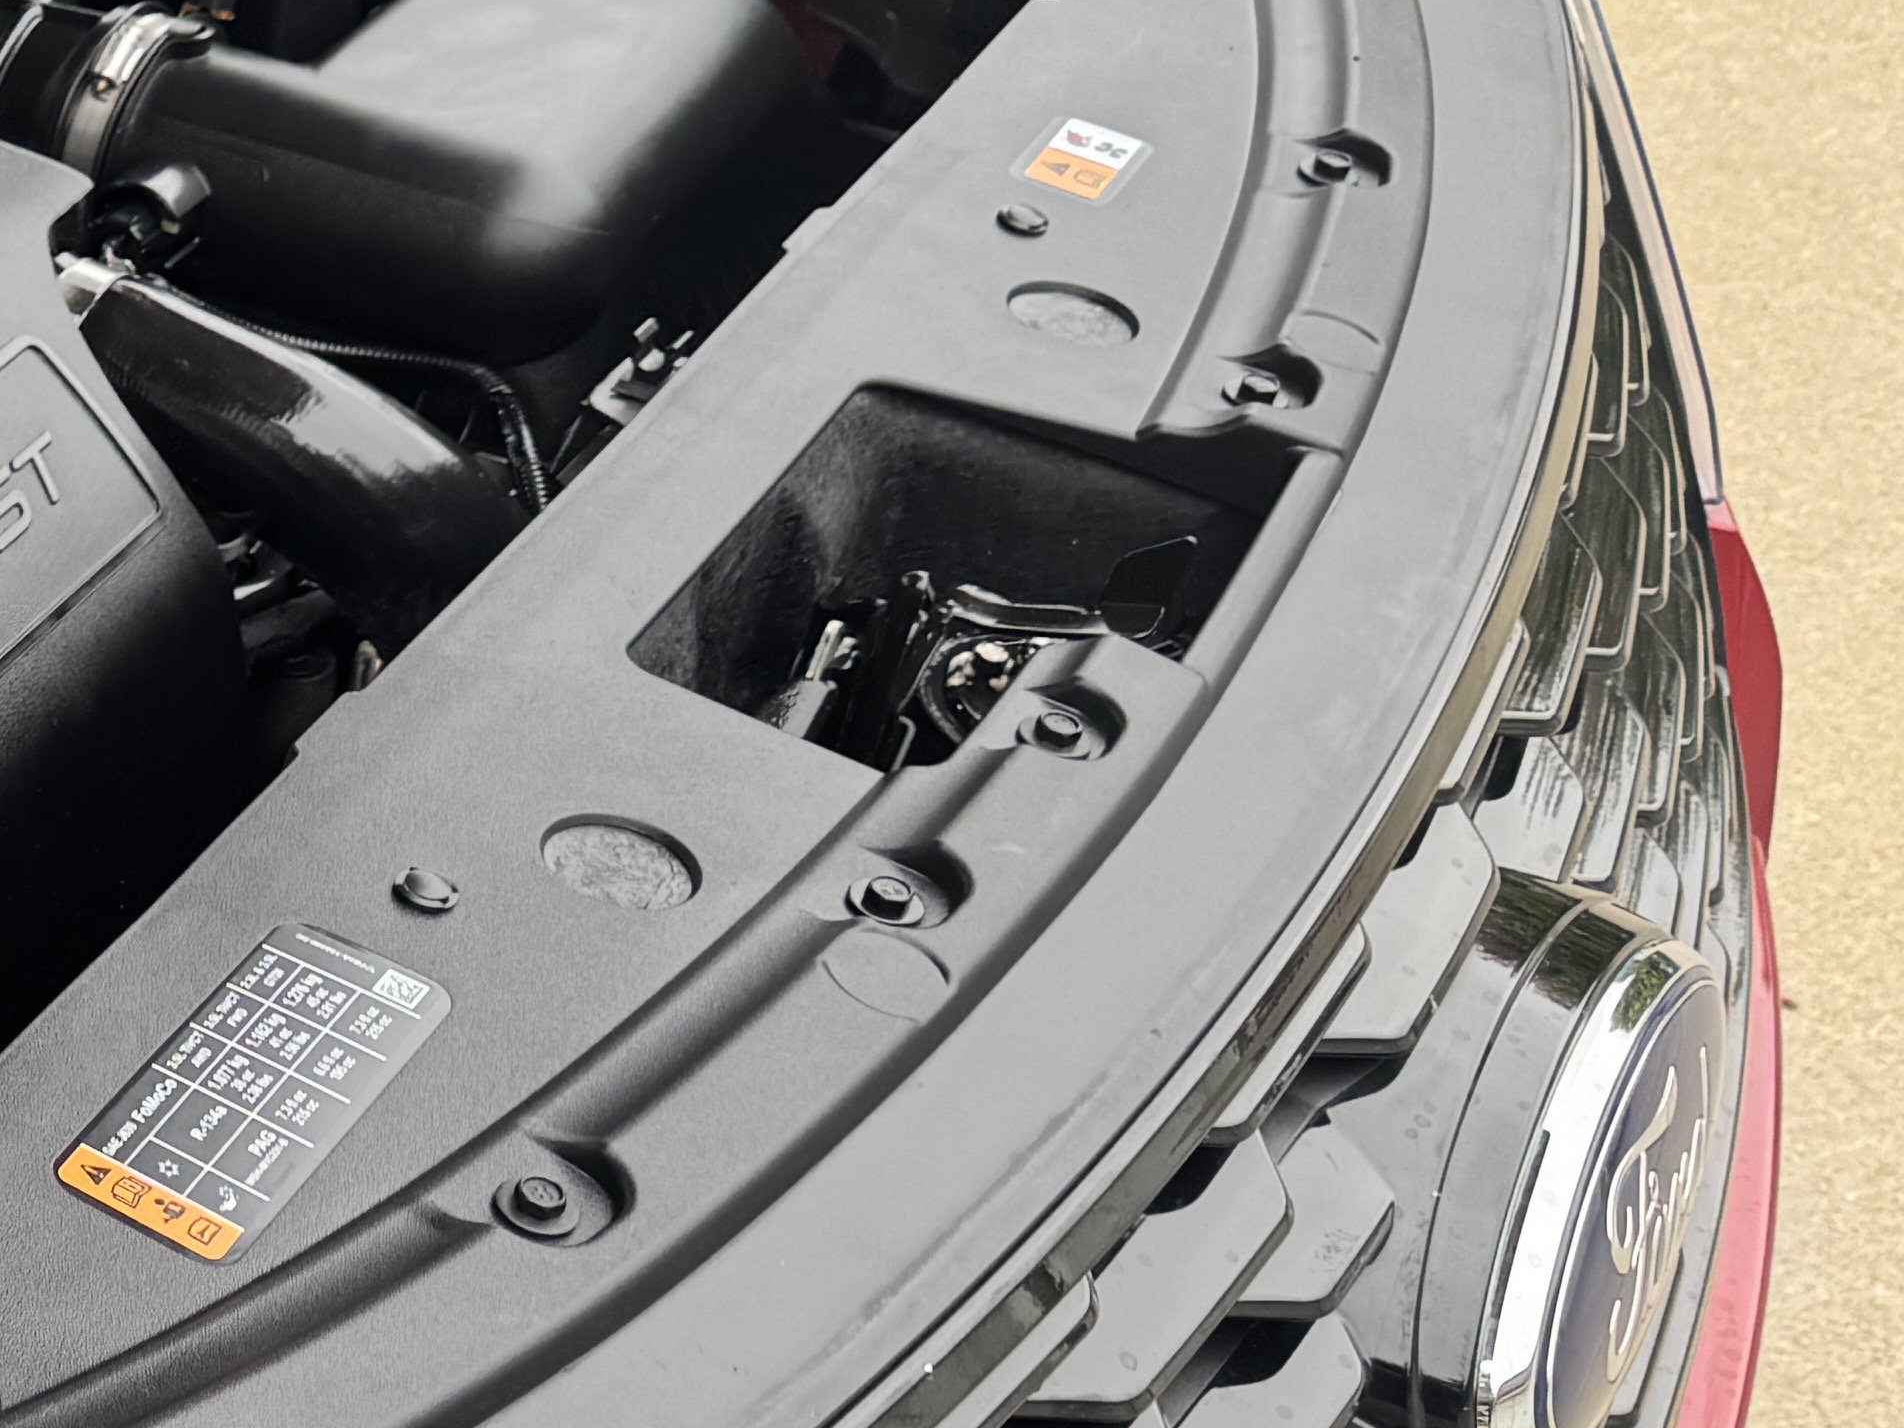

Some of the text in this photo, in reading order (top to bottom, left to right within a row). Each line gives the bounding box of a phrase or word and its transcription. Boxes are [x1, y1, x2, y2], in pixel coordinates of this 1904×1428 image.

[130, 1078, 177, 1123] FoMoCo
[189, 1104, 228, 1141] R-134a
[246, 1128, 277, 1157] PAG
[1604, 1043, 1711, 1383] Ford
